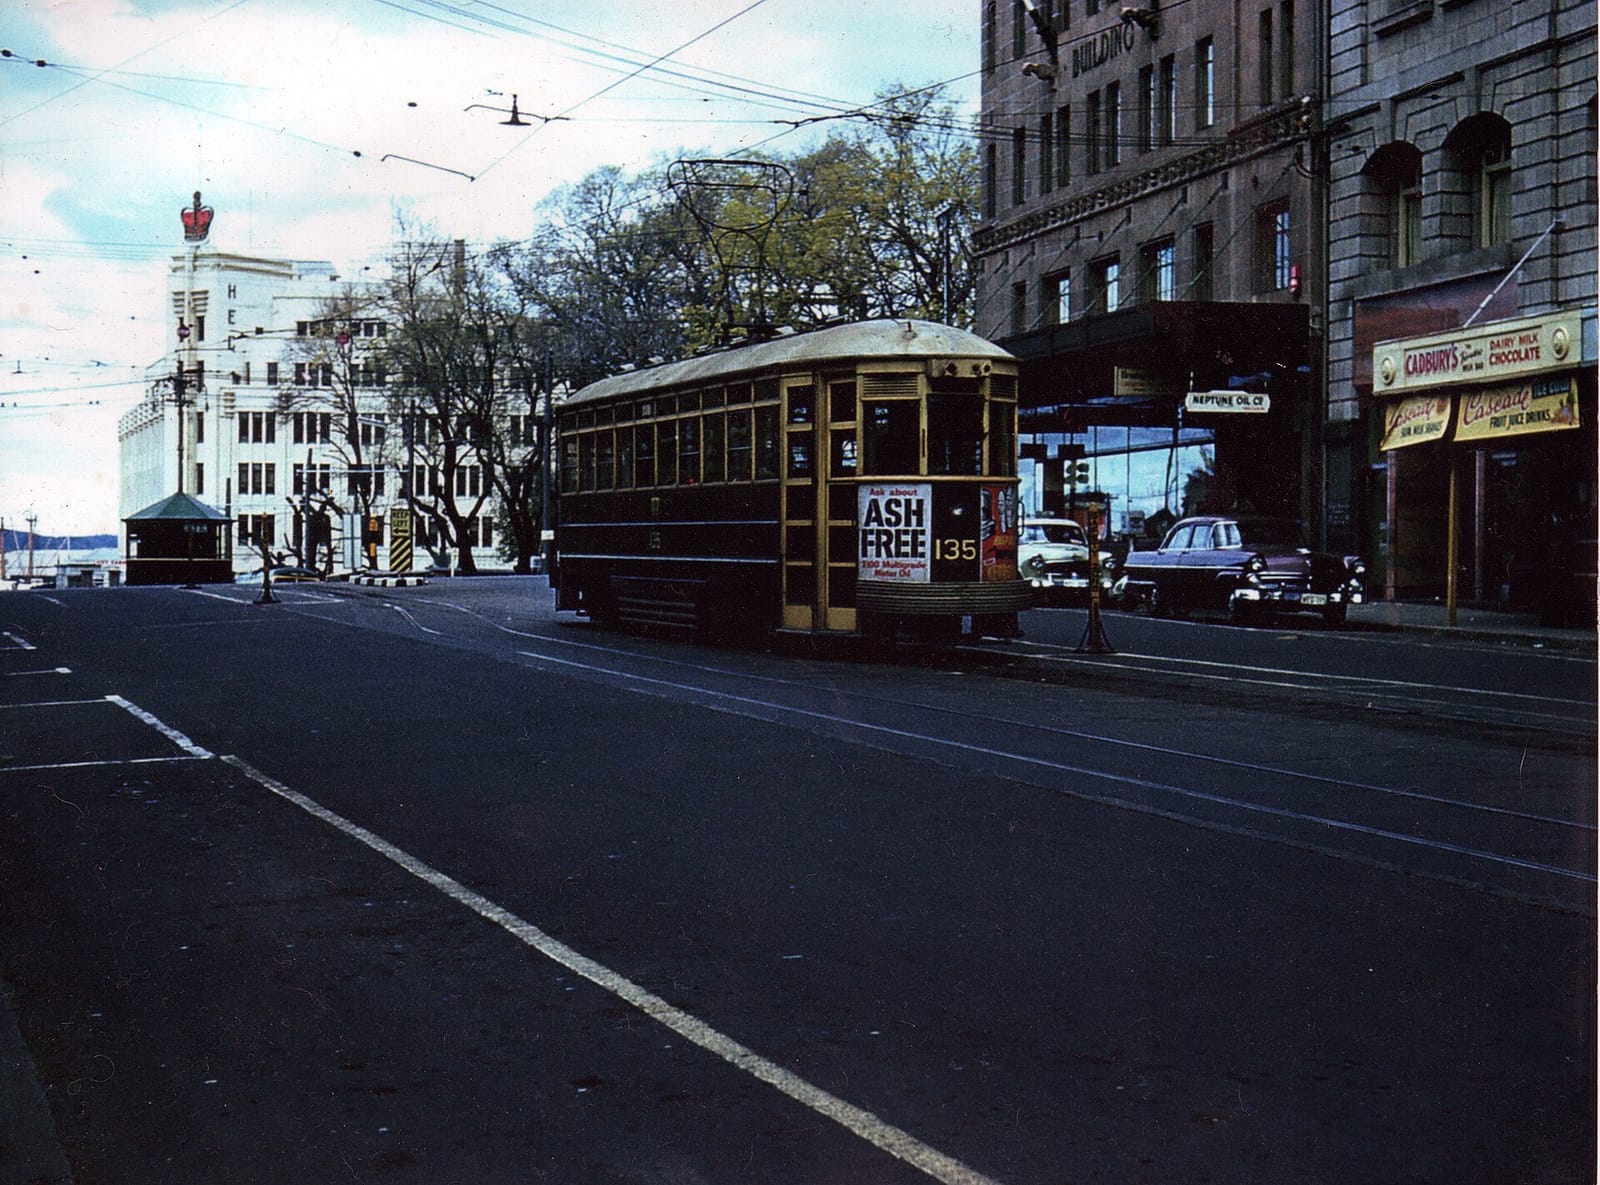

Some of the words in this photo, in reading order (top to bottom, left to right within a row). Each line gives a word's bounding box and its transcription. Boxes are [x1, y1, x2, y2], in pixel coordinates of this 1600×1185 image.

[1072, 22, 1135, 78] BUILDING
[1490, 337, 1516, 350] DAIRY
[1519, 332, 1538, 345] MILK
[1406, 343, 1459, 375] CADBURY'S
[1489, 346, 1541, 366] CHOCOLATE
[1193, 395, 1234, 407] NEPTUNE
[1237, 396, 1251, 406] OIL
[1463, 387, 1530, 426] Cascade
[1489, 414, 1507, 430] FRUIT
[1506, 412, 1524, 431] JUICE
[1526, 409, 1551, 425] DRINKS
[869, 487, 885, 496] Ask
[889, 487, 918, 497] about
[392, 511, 409, 519] KEEP
[864, 498, 924, 527] ASH
[392, 519, 408, 528] LEFT
[861, 529, 926, 558] FREE
[935, 538, 977, 561] 135
[875, 569, 897, 577] Motor
[899, 569, 911, 577] Oil
[882, 560, 927, 570] Multigrade
